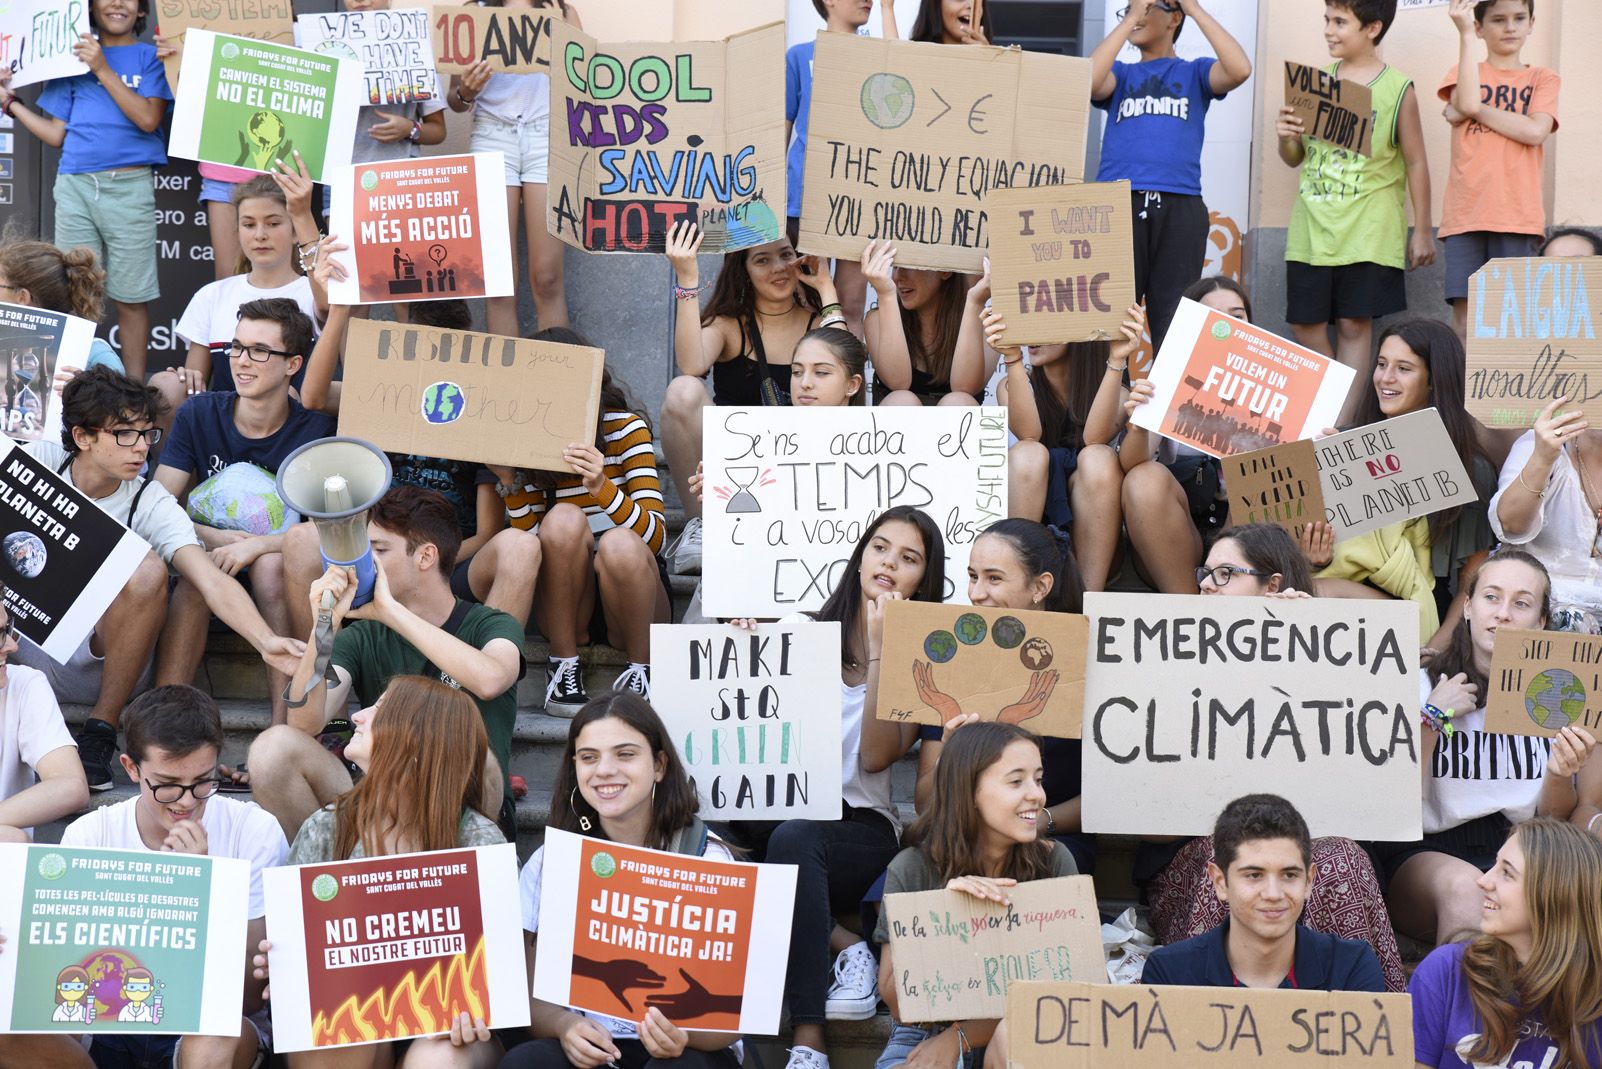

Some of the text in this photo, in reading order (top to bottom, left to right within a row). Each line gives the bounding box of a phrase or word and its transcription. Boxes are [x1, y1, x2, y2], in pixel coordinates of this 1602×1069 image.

[10, 36, 25, 74] el
[31, 1, 82, 63] FUTUR
[320, 13, 365, 41] WE
[436, 13, 475, 66] 10
[243, 48, 280, 62] FRIDAYS
[281, 55, 298, 65] FOR
[299, 59, 332, 73] FUTURE
[363, 42, 423, 69] HAVE
[564, 41, 712, 103] COOL
[219, 67, 327, 99] CANVIEM EL SISTEMA
[1285, 61, 1341, 103] VOLEM
[216, 81, 325, 120] NO EL CLIMA
[1116, 94, 1190, 124] FORTNITE
[566, 96, 669, 148] KIDS
[154, 171, 191, 190] ixer
[380, 168, 415, 180] FRIDAYS
[417, 167, 434, 178] FOR
[436, 165, 468, 176] FUTURE
[827, 141, 882, 188] THE
[891, 150, 951, 193] ONLY
[369, 190, 459, 212] MENYS DEBAT
[553, 184, 690, 251] A HOT
[702, 201, 751, 226] PLANET
[361, 207, 472, 245] MÉS ACCIÓ
[825, 194, 943, 246] YOU SHOULD
[1019, 205, 1114, 236] I WANT
[1032, 239, 1092, 262] YOU TO
[1017, 272, 1112, 314] PANIC
[1475, 256, 1596, 340] L'AIGUA
[6, 310, 22, 320] FOR
[24, 314, 59, 327] FUTURE
[377, 329, 518, 367] RESPECT
[1233, 329, 1270, 349] FRIDAYS
[1270, 345, 1287, 357] FOR
[1288, 353, 1321, 372] FUTURE
[1225, 352, 1288, 390] VOLEM UN
[1202, 365, 1289, 422] FUTUR
[829, 412, 906, 456] acaba
[937, 412, 973, 460] el
[7, 459, 80, 520] NO HI HA
[777, 461, 934, 512] TEMPS
[1330, 454, 1401, 491] IS NO
[1433, 470, 1459, 498] B
[63, 532, 80, 551] B
[731, 506, 976, 546] i a les
[18, 598, 52, 625] FUTURE
[689, 632, 794, 681] MAKE
[1519, 638, 1554, 660] STOP
[711, 684, 780, 721] StQ
[684, 720, 802, 767] GREEN
[72, 858, 125, 871] FRIDAYS
[128, 861, 151, 872] FOR
[155, 863, 202, 877] FUTURE
[95, 872, 173, 884] SANT CUGAT DEL VALLÈS
[341, 863, 467, 887] FRIDAYS FOR FUTURE
[620, 859, 670, 878] FRIDAYS
[673, 868, 696, 882] FOR
[700, 873, 747, 888] FUTURE
[35, 889, 61, 900] TOTES
[63, 890, 79, 900] LES
[138, 893, 149, 904] DE
[151, 894, 199, 907] DESASTRES
[366, 878, 442, 894] SANT CUGAT DEL VALLÈS
[642, 876, 718, 894] SANT CUGAT DEL VALLÈS
[32, 904, 198, 922] COMENCEN AMB ALGÚ IGNORANT
[325, 906, 461, 945] NO CREMEU
[591, 889, 737, 934] JUSTÍCIA
[893, 920, 907, 938] De
[912, 915, 927, 938] la
[29, 920, 197, 950] ELS CIENTÍFICS
[329, 937, 462, 966] EL NOSTRE FUTUR
[588, 919, 733, 962] CLIMÀTICA JA!
[902, 969, 919, 997] la
[1034, 988, 1176, 1051] DEMÀ
[1196, 1002, 1263, 1057] JA
[1287, 999, 1394, 1057] SERÀ
